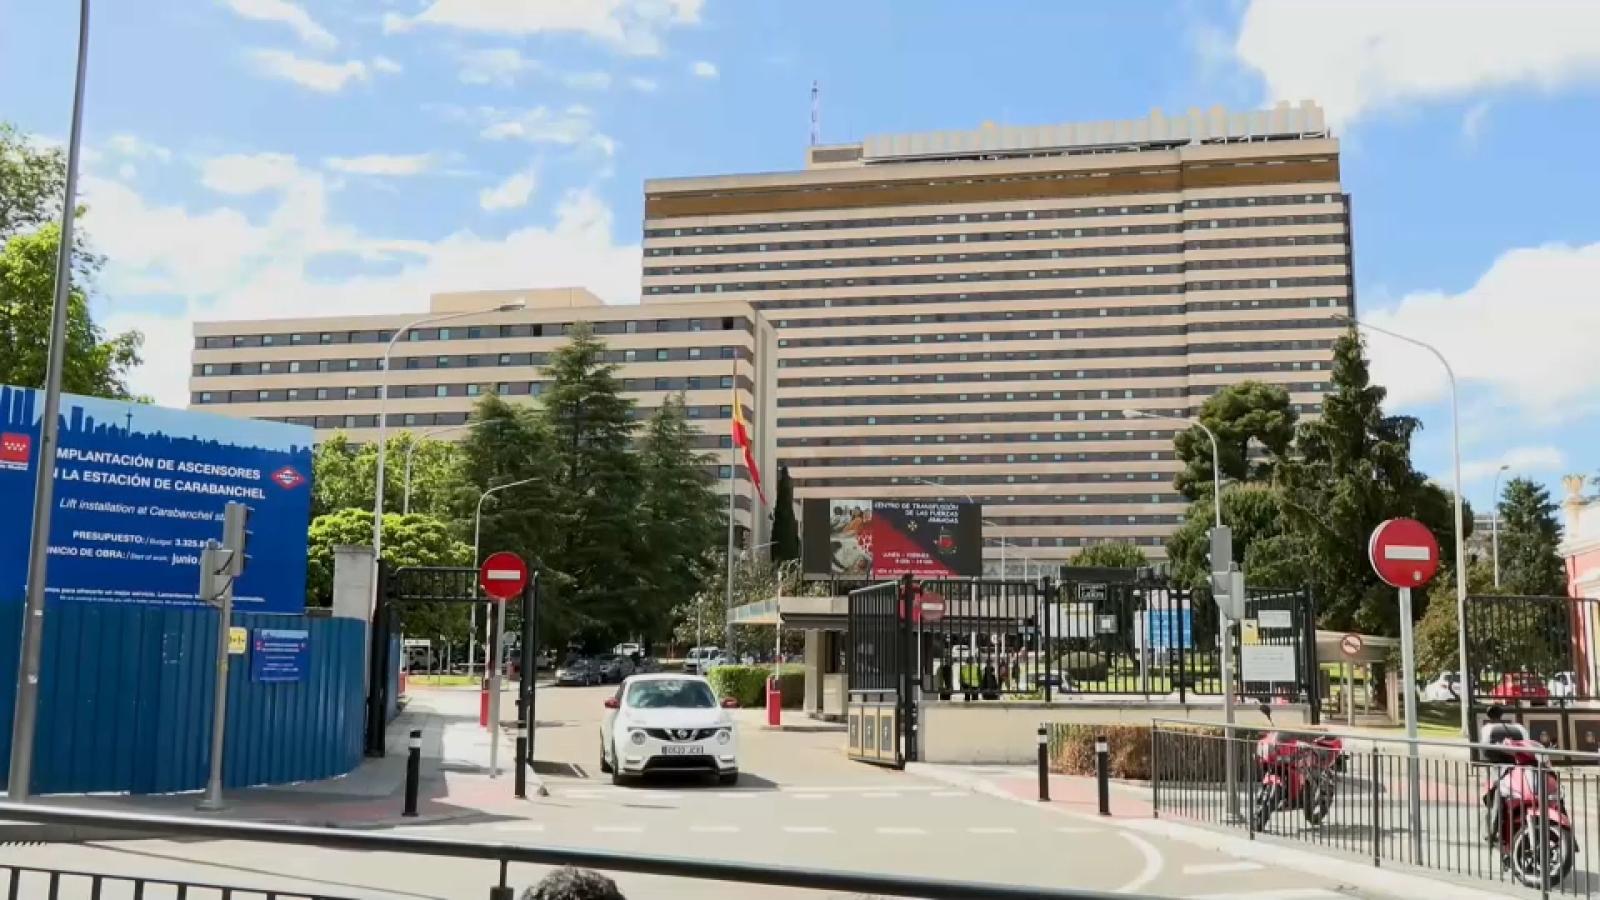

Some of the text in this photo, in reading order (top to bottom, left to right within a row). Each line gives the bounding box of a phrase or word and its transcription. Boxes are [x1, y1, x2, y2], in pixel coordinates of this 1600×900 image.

[56, 447, 261, 481] MPLANTACIÓN DE ASCENSORES
[62, 468, 79, 480] LA
[83, 469, 150, 488] ESTACIÓN
[154, 478, 171, 490] DE
[174, 480, 265, 499] CARABANCHEL
[79, 499, 136, 514] installation
[137, 505, 148, 515] at
[149, 506, 213, 521] Carabanchel
[80, 548, 94, 557] DE
[95, 549, 126, 559] OBRA:
